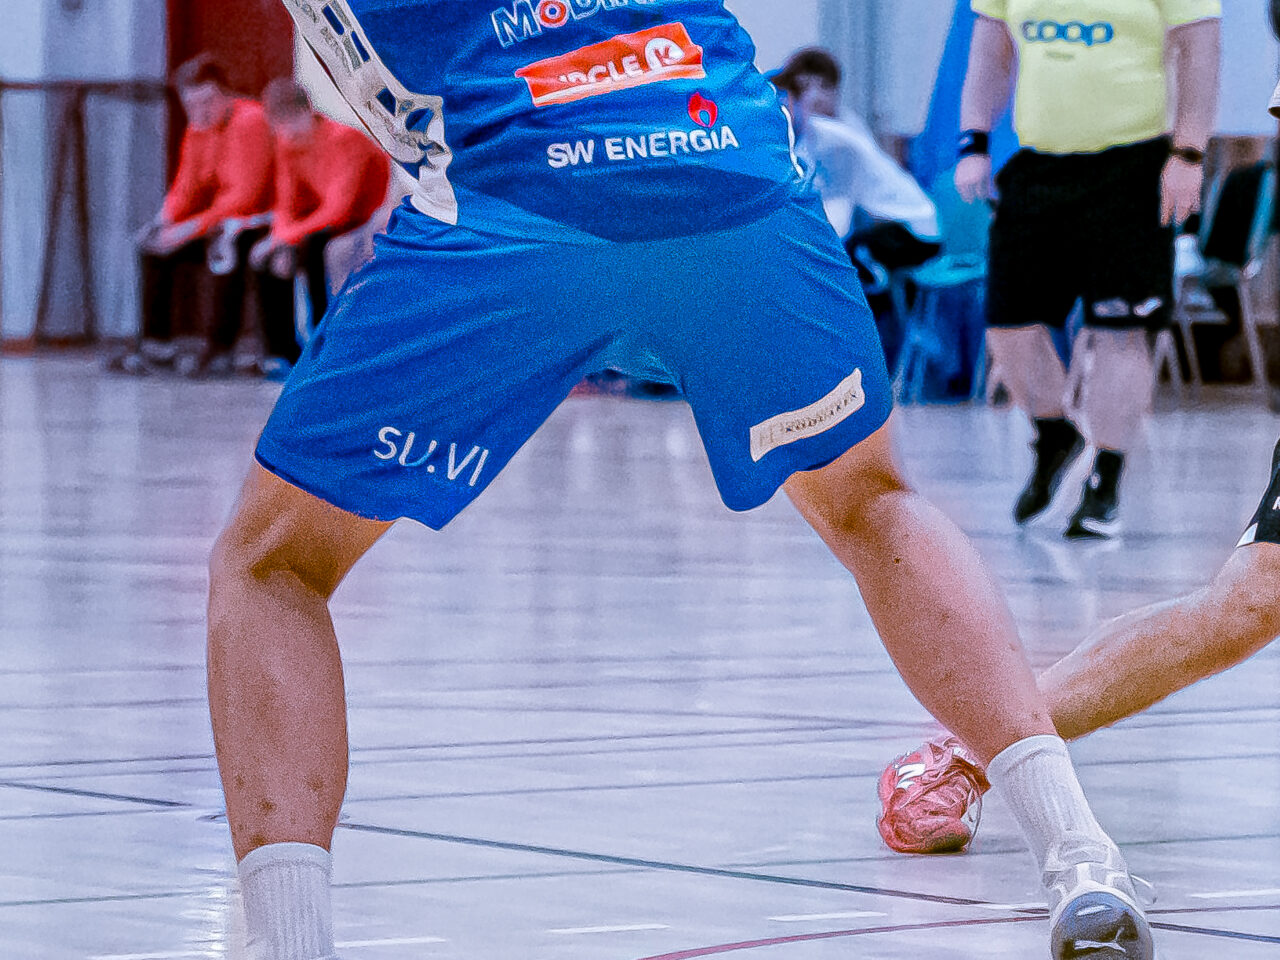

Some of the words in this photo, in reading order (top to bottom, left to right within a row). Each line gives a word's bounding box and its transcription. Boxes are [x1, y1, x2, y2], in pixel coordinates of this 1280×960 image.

[546, 139, 595, 169] SW
[604, 125, 740, 161] ENERGIA
[373, 426, 490, 487] SU.VI
